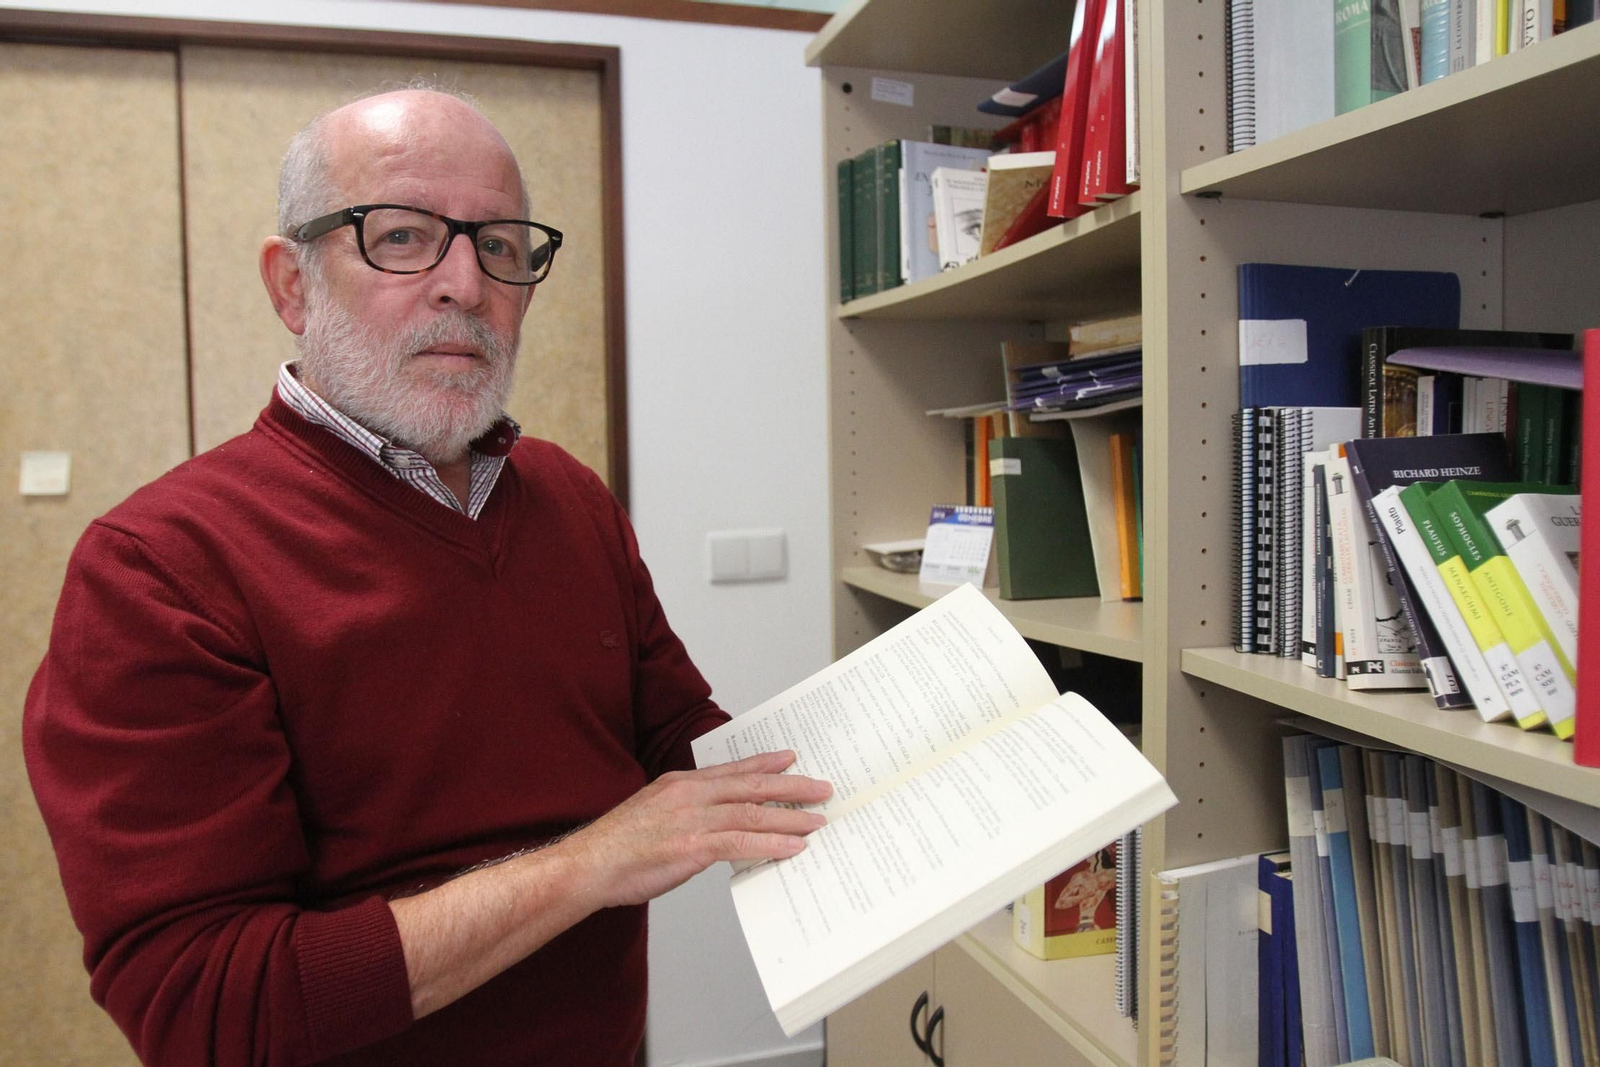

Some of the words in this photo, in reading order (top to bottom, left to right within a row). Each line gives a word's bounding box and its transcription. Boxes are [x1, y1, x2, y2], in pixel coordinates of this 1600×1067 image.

[1335, 0, 1369, 25] ROMA
[1393, 468, 1438, 478] RICHARD
[1440, 466, 1482, 477] HEINZE
[1387, 505, 1406, 535] Plauto
[1422, 520, 1447, 558] PLAUTUS
[1448, 567, 1482, 620] MENAECHMI
[1450, 512, 1482, 561] SOPHOCLES
[1484, 571, 1514, 618] ANTIGONE
[1446, 674, 1459, 692] EUT
[1500, 667, 1519, 682] CAM
[1504, 676, 1520, 690] PLA
[1534, 668, 1552, 682] CAM
